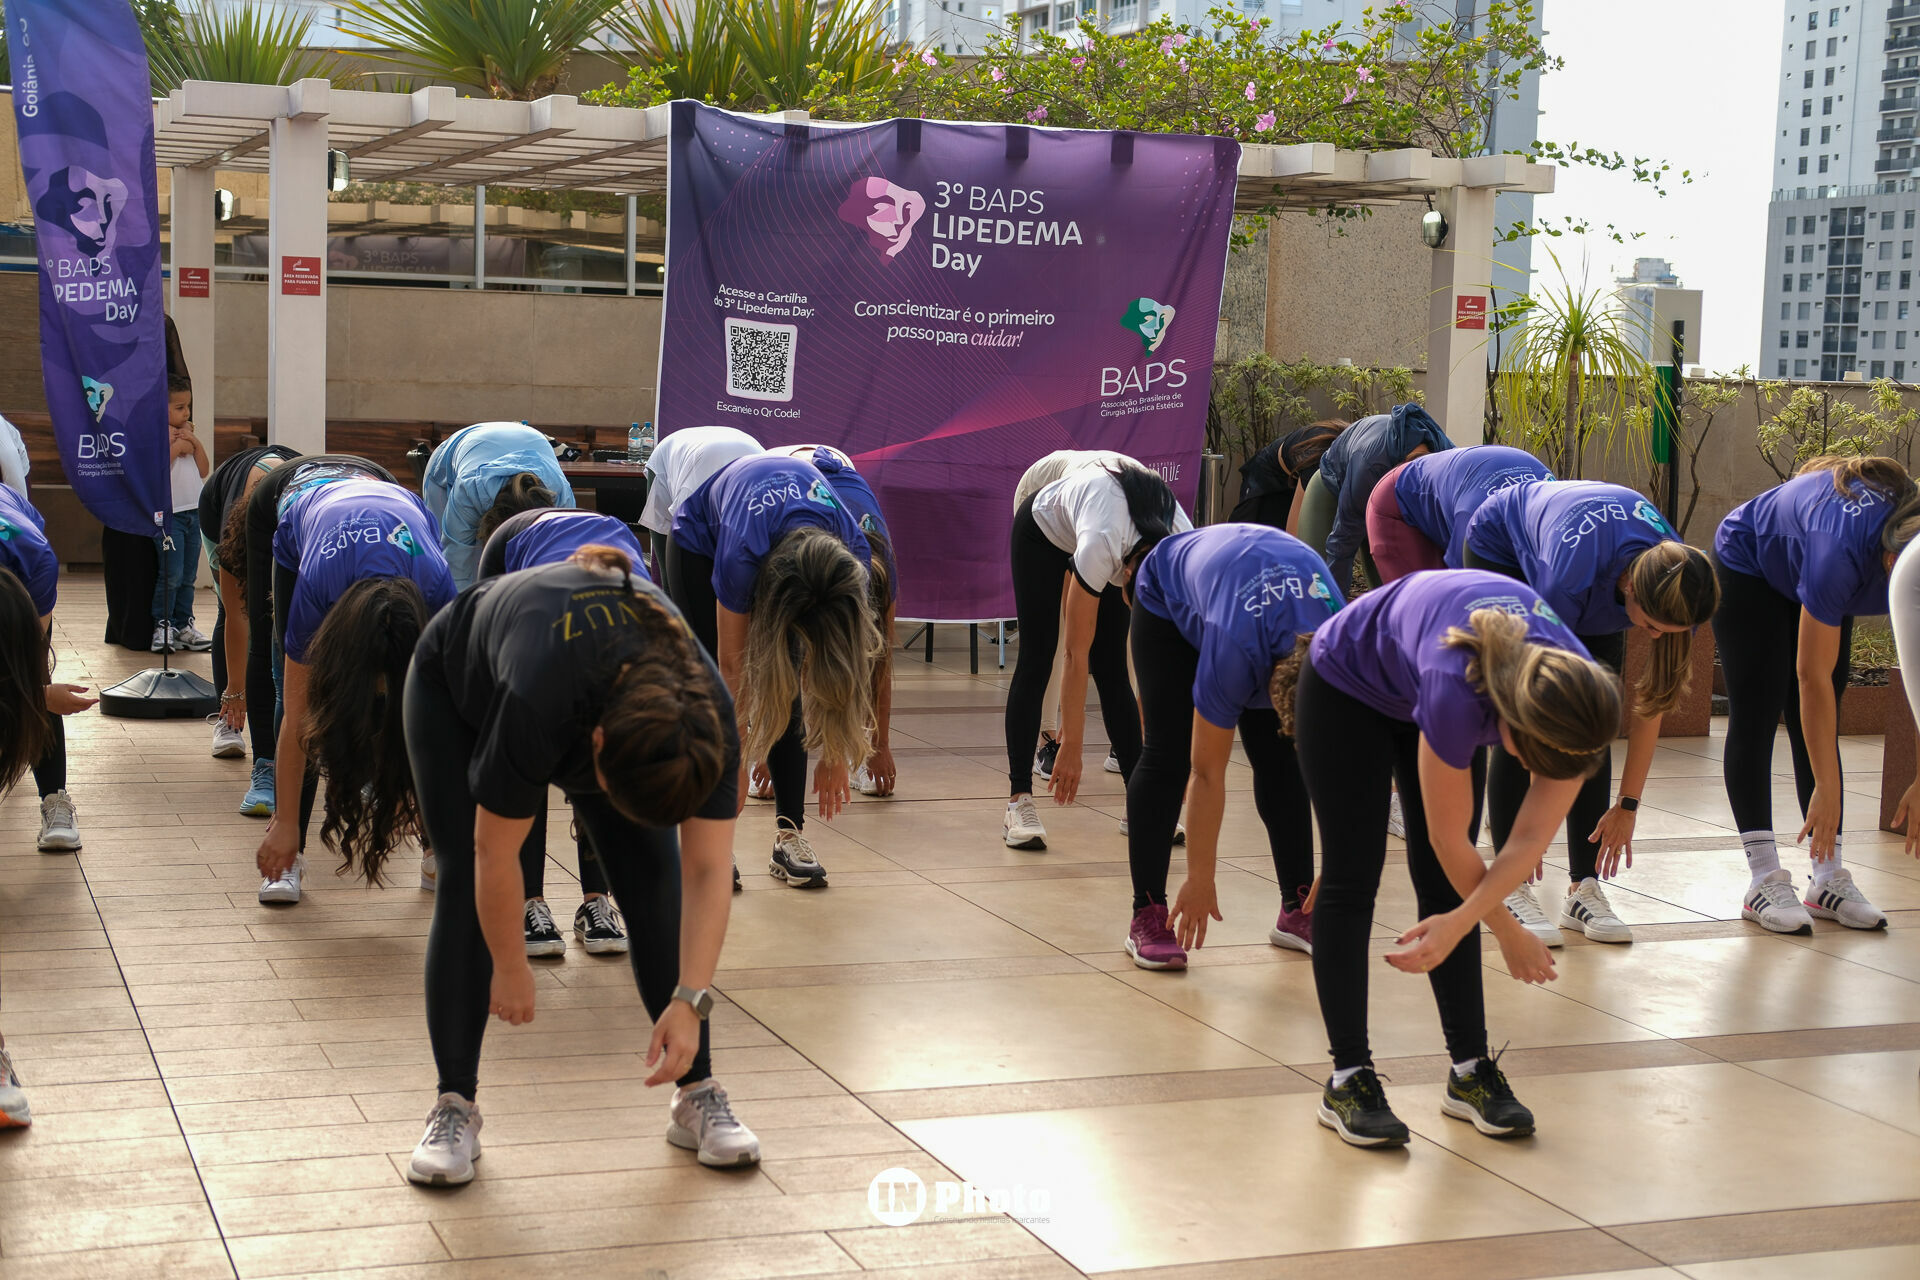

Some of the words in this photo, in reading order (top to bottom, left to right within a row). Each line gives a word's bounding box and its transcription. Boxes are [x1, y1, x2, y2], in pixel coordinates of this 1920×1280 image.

[934, 181, 963, 208] 3º
[969, 186, 1044, 214] BAPS
[932, 213, 1083, 246] LIPEDEMA
[58, 255, 112, 278] BAPS
[932, 243, 983, 278] Day
[54, 277, 138, 304] PEDEMA
[718, 284, 756, 300] Acesse
[758, 293, 764, 301] a
[766, 291, 808, 304] Cartilha
[105, 301, 139, 323] Day
[713, 295, 723, 307] do
[737, 300, 790, 316] Lipedema
[792, 306, 815, 318] Day:
[854, 299, 961, 321] Conscientizar
[962, 307, 972, 323] é
[974, 311, 985, 323] o
[988, 308, 1055, 328] primeiro
[886, 325, 935, 342] passo
[936, 329, 968, 346] para
[970, 328, 1024, 348] cuidar!
[1100, 358, 1188, 396] BAPS
[760, 407, 772, 417] Qr
[1100, 398, 1138, 409] Associação
[1139, 394, 1171, 404] Brasileira
[1172, 392, 1182, 400] de
[1100, 409, 1126, 418] Cirurgia
[1127, 403, 1155, 415] Plástica
[1155, 401, 1184, 411] Estética
[77, 432, 126, 459] BAPS
[748, 482, 802, 516] BAPS
[1562, 503, 1629, 549] BAPS
[320, 527, 381, 560] BAPS
